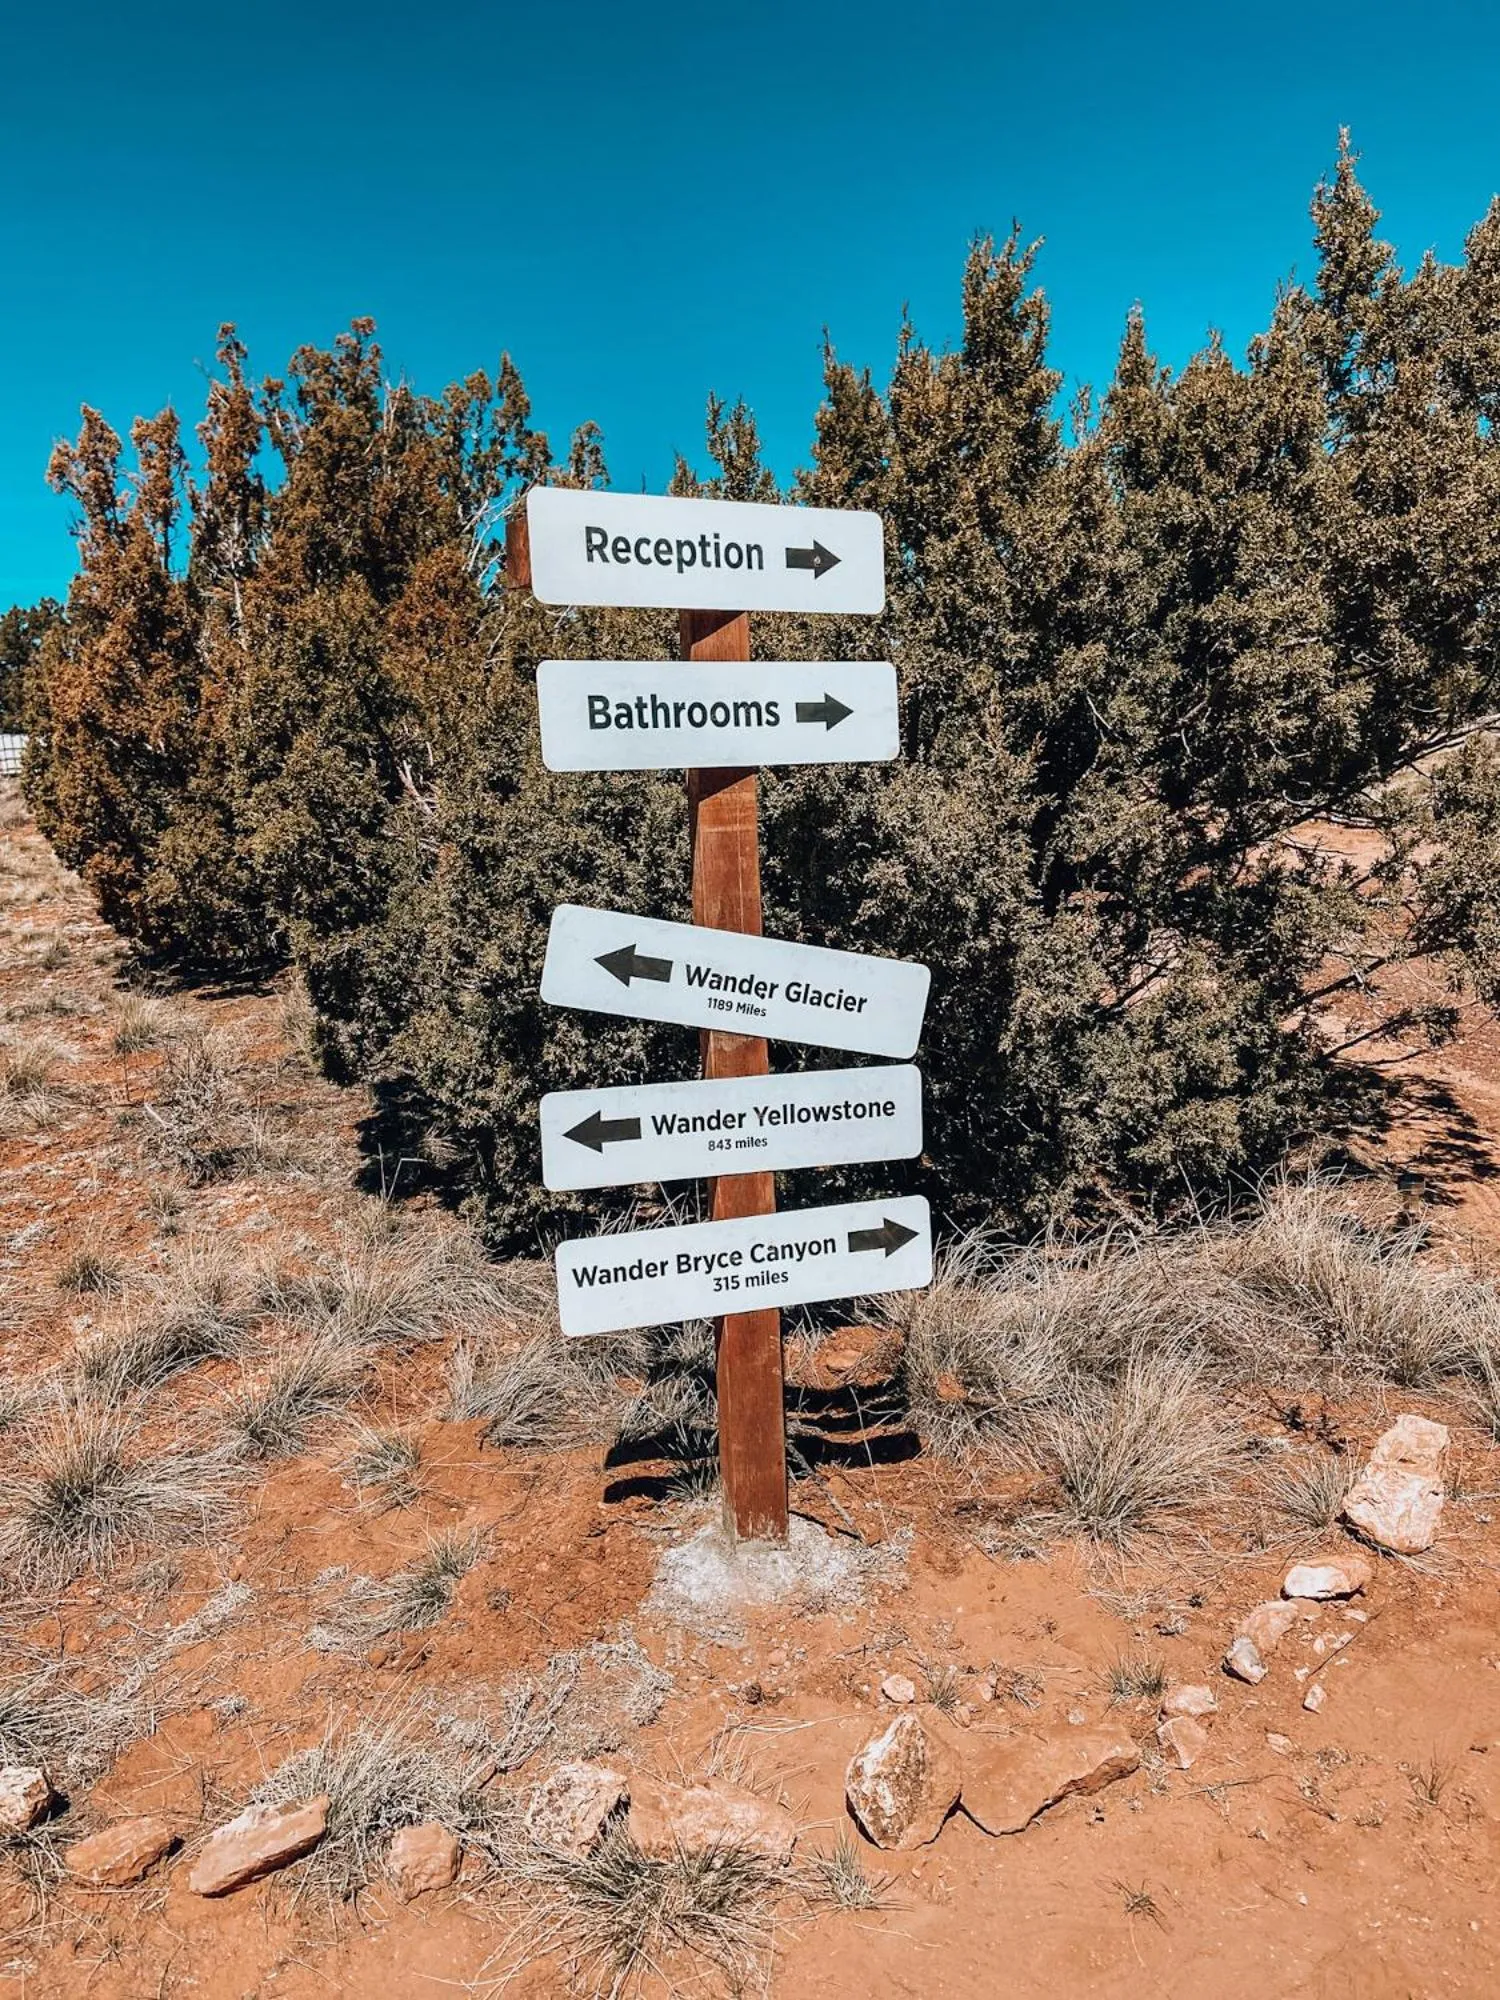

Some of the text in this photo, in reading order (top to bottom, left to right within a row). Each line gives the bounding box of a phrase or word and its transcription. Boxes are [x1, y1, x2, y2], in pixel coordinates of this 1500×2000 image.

[584, 525, 764, 574] Reception
[587, 693, 781, 730] Bathrooms
[685, 963, 868, 1013] Wander Glacier
[707, 997, 767, 1017] 1189 Miles
[651, 1100, 896, 1136] Wander Yellowstone
[708, 1136, 768, 1152] 843 miles
[572, 1237, 837, 1288] Wander Bryce Canyon
[713, 1270, 789, 1293] 315 miles
